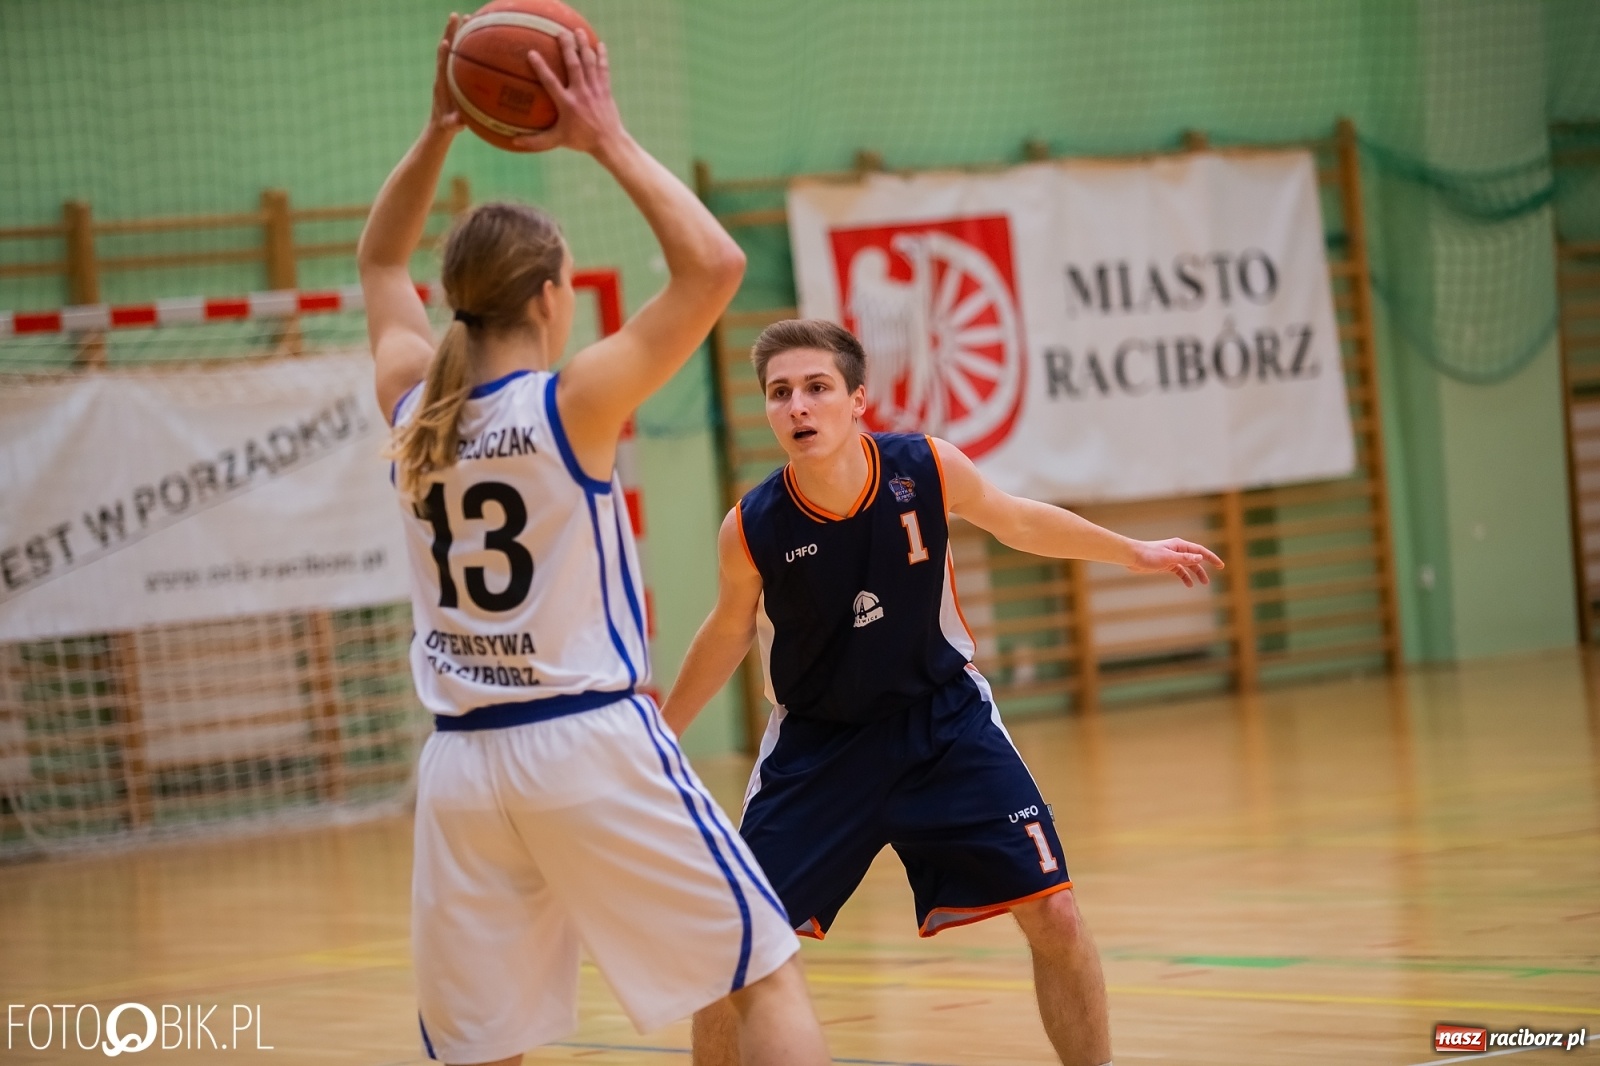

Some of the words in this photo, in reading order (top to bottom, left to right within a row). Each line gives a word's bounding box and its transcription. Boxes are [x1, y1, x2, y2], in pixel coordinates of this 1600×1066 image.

[1063, 248, 1278, 319] MIASTO
[1043, 315, 1321, 401] RACIBÓRZ
[83, 499, 127, 549] W
[412, 481, 535, 612] 13
[900, 510, 930, 566] 1
[1024, 821, 1059, 874] 1
